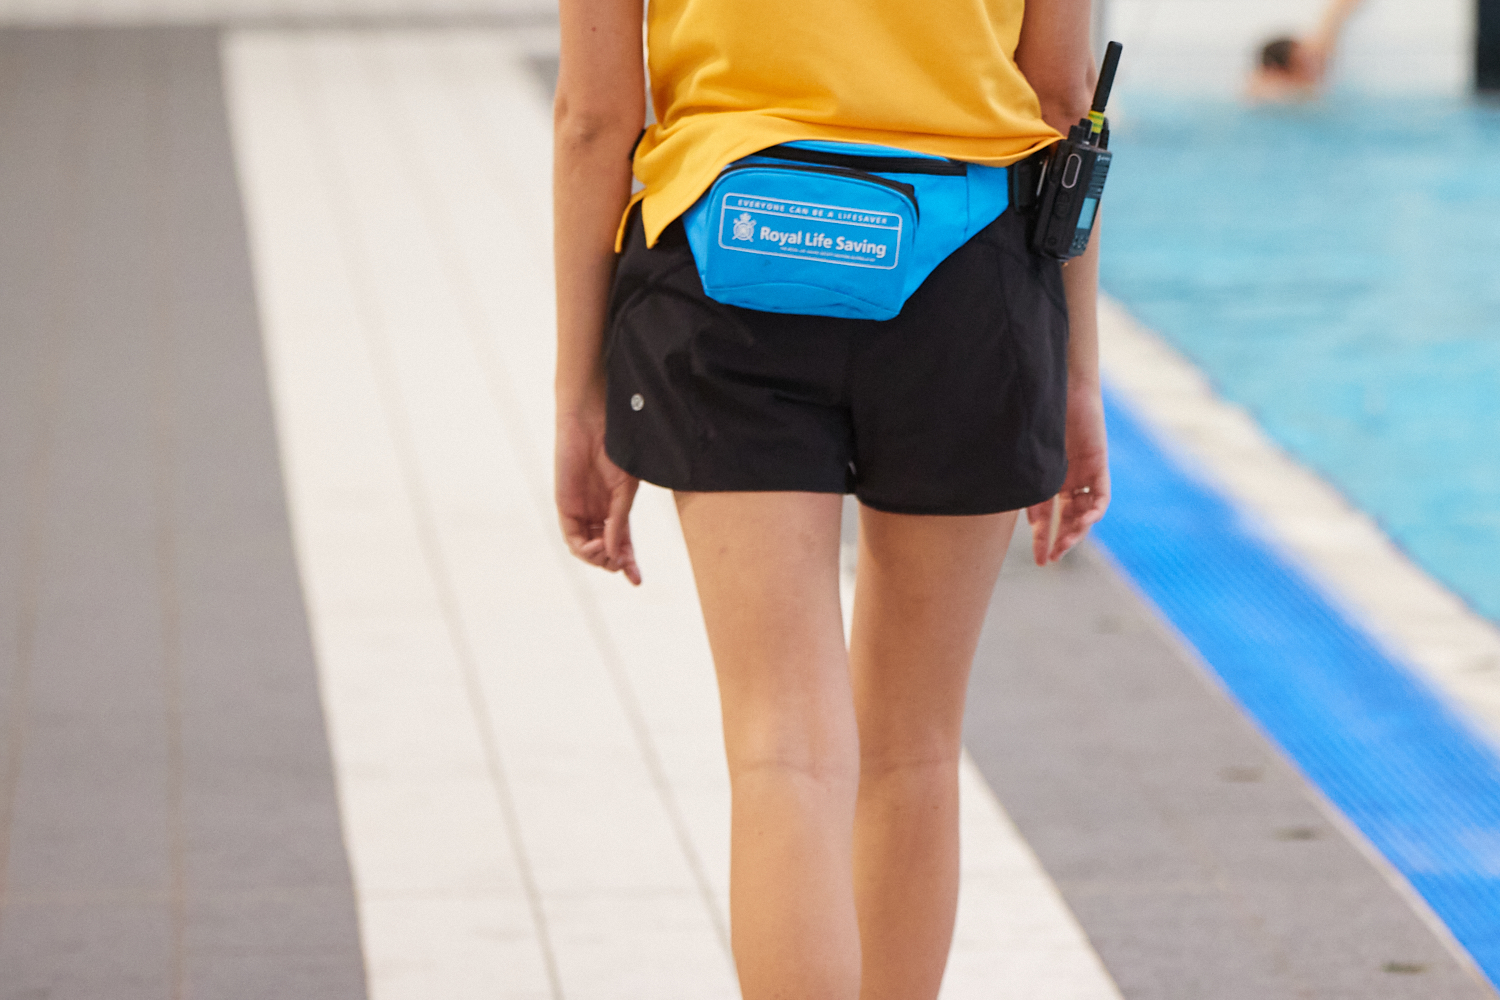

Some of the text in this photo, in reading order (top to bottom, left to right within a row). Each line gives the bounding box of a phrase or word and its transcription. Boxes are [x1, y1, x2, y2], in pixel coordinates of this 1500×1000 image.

[738, 199, 785, 212] EVERYONE
[789, 205, 809, 215] CAN
[812, 208, 824, 217] BE
[837, 212, 888, 224] LIFESAVER
[760, 226, 803, 246] Royal
[805, 232, 833, 249] Life
[835, 236, 887, 259] Saving
